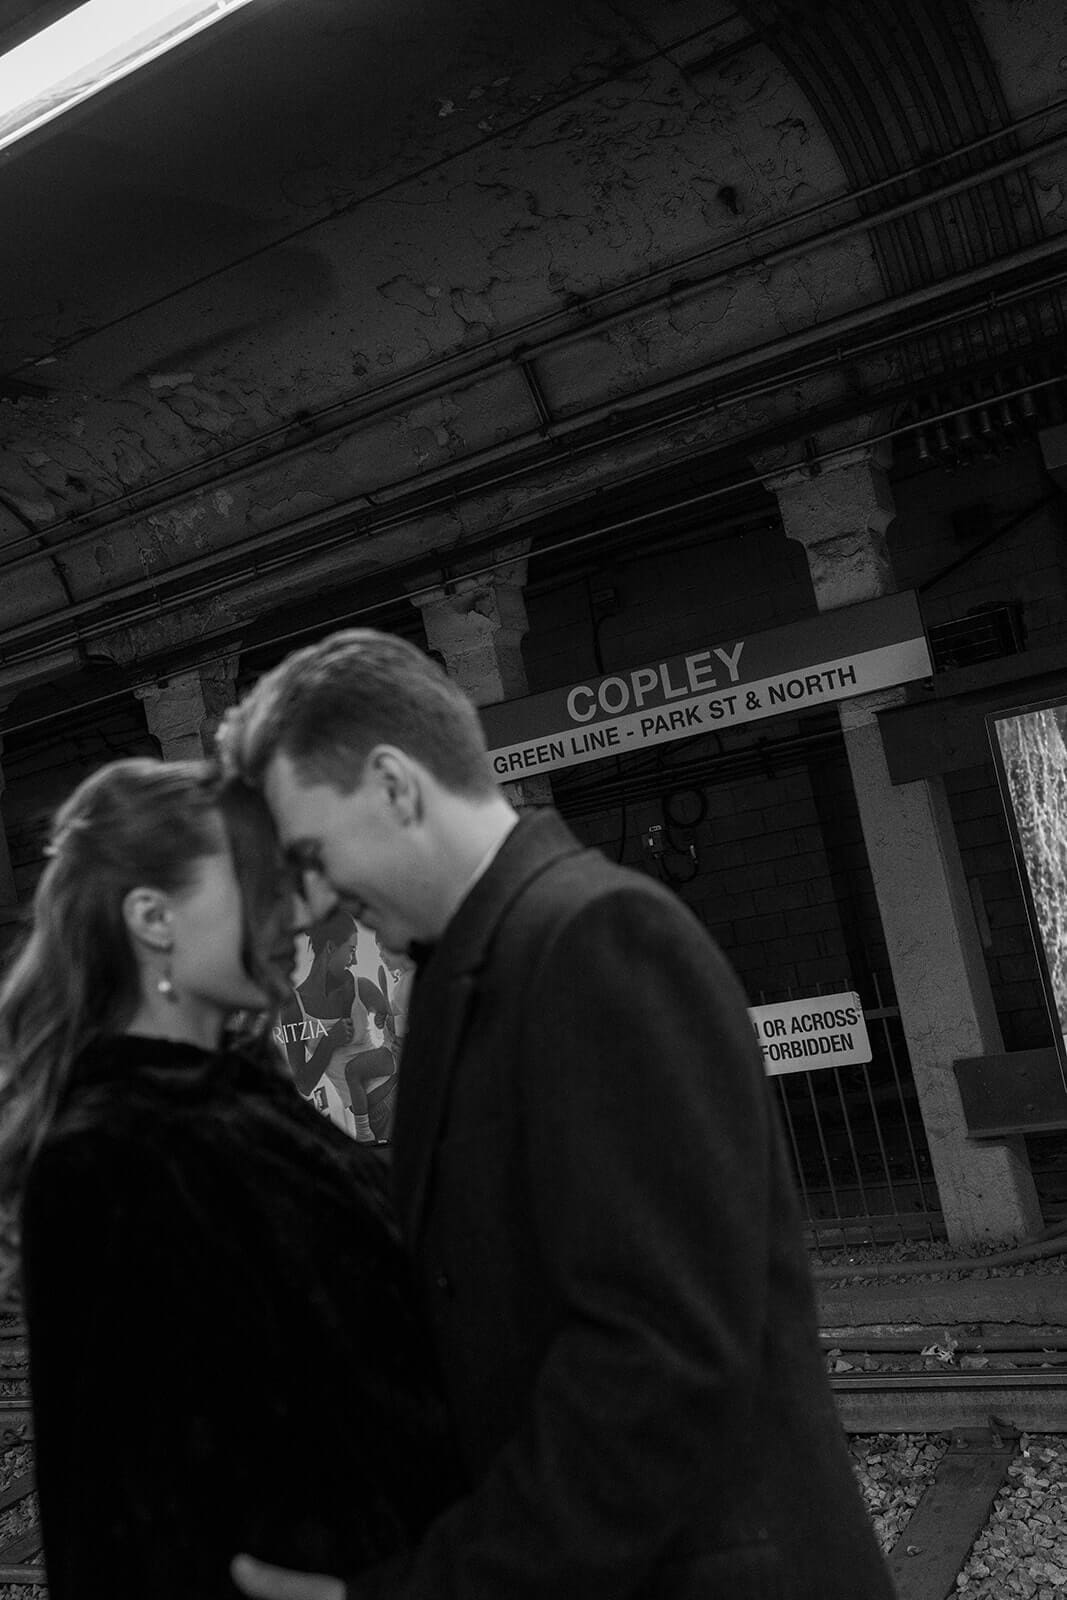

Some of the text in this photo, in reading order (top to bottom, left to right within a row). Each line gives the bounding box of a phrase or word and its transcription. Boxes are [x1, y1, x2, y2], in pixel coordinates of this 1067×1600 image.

[567, 641, 745, 722] COPLEY
[493, 741, 565, 774] GREEN
[571, 726, 620, 755] LINE
[640, 705, 702, 737] PARK
[709, 696, 737, 719] ST
[746, 691, 762, 710] &
[768, 665, 857, 705] NORTH
[760, 1033, 854, 1062] FORBIDDEN
[763, 1019, 787, 1038] OR
[791, 1008, 858, 1034] ACROSS
